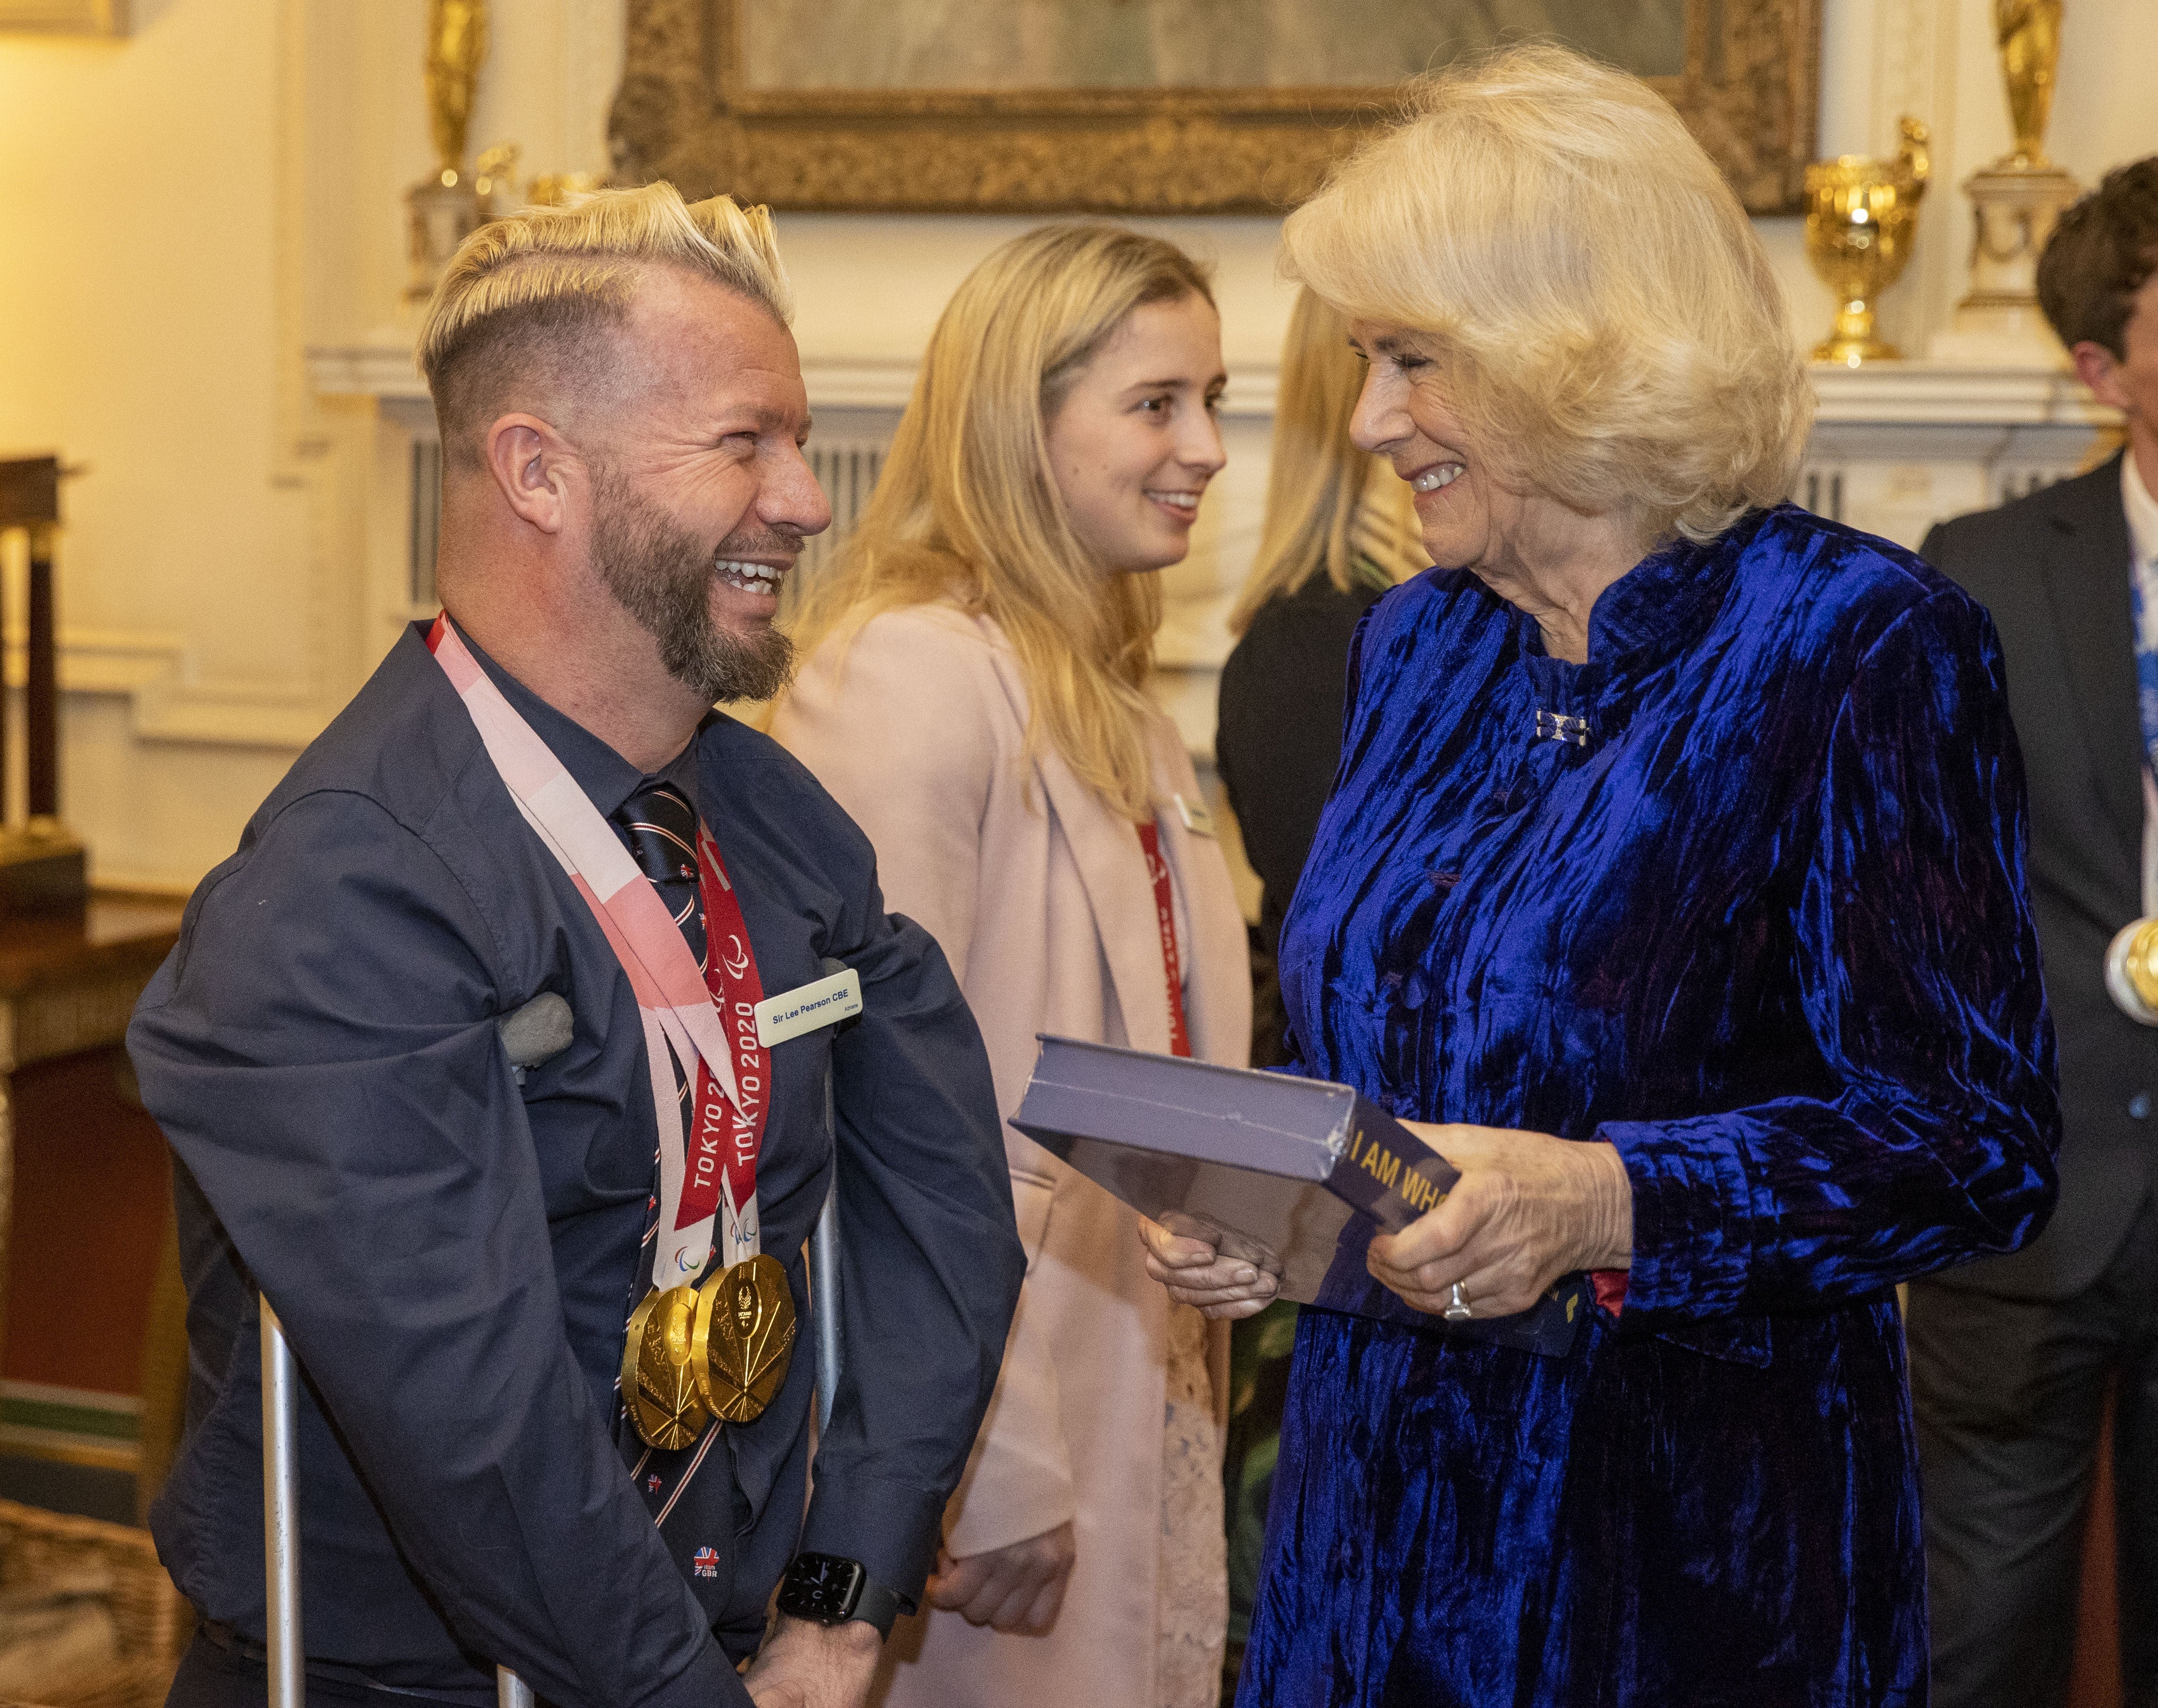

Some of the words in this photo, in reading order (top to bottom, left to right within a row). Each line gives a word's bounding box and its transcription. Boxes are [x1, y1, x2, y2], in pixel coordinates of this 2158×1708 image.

[735, 1002, 760, 1069] 2020
[772, 1014, 783, 1024] Sir
[785, 1010, 799, 1020] Lee
[800, 997, 831, 1014] Pearson
[832, 989, 849, 1001] CBE
[694, 1103, 722, 1188] TOKYO
[732, 1076, 760, 1167] TOKYO
[1350, 1129, 1364, 1161] I
[1361, 1141, 1401, 1189] AM
